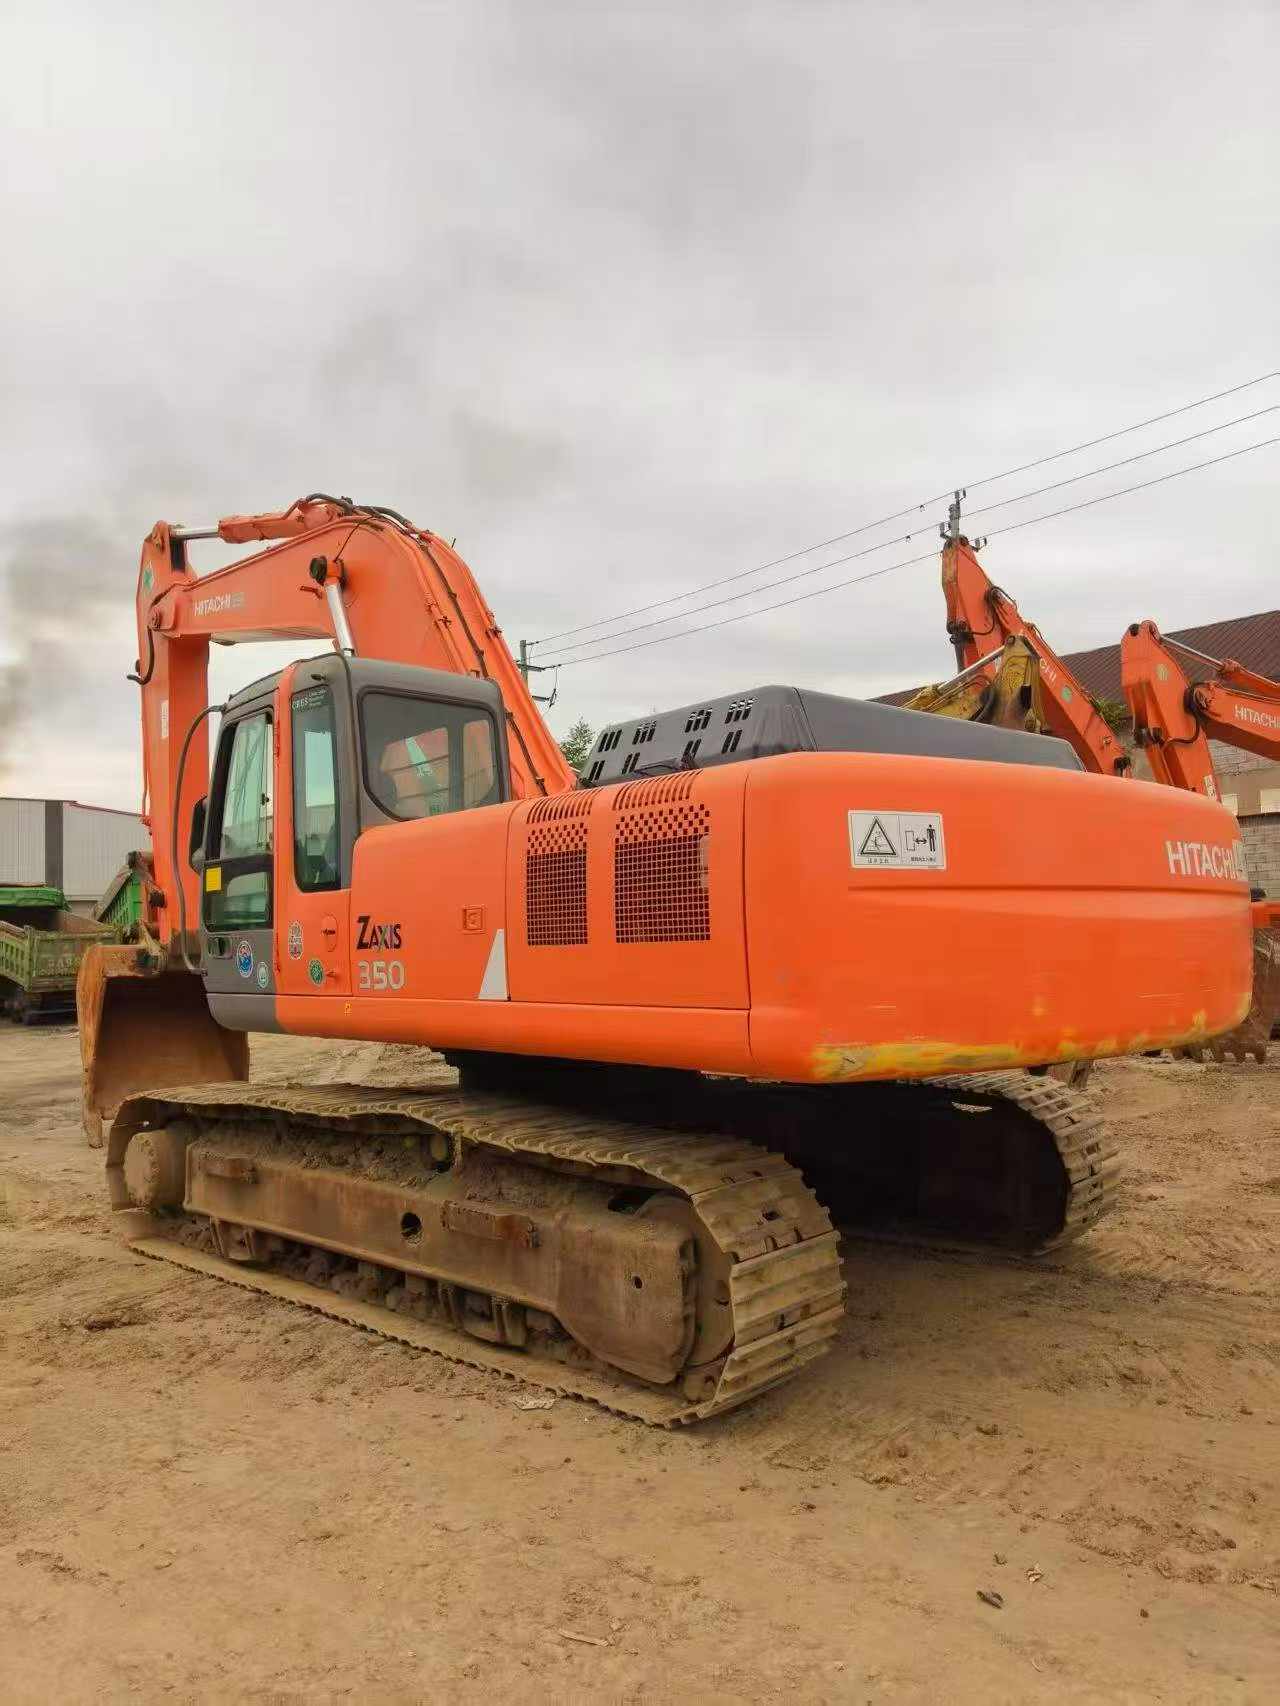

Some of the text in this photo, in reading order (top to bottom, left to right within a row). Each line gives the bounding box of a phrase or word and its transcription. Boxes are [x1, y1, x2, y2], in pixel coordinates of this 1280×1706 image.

[193, 593, 231, 616] HITACHI
[1165, 840, 1239, 880] HITACHI
[357, 916, 402, 950] ZAXIS
[358, 960, 405, 989] 350
